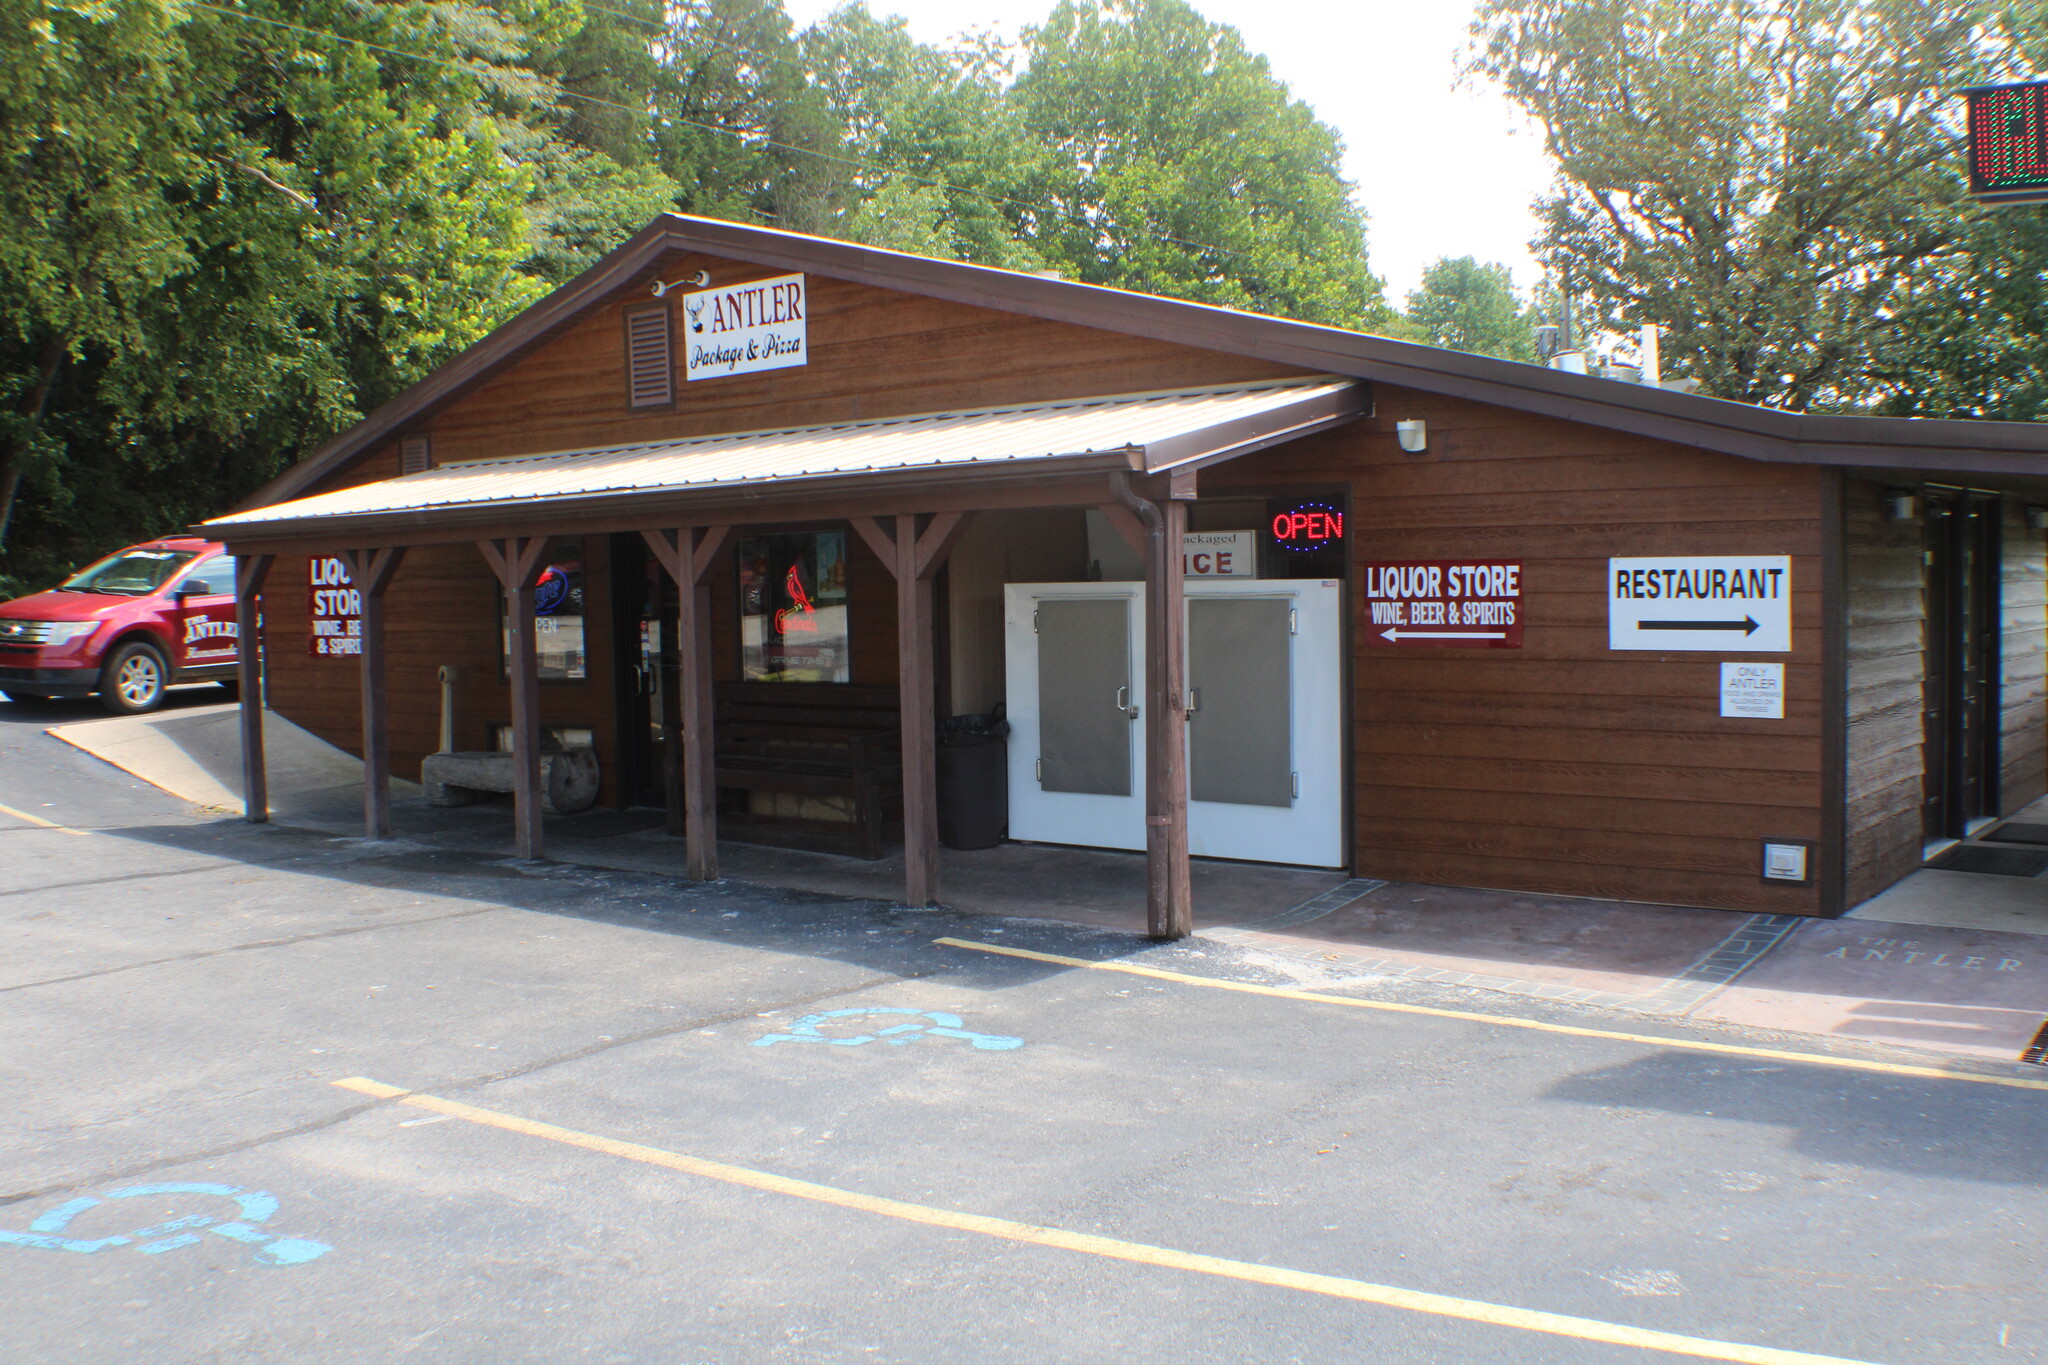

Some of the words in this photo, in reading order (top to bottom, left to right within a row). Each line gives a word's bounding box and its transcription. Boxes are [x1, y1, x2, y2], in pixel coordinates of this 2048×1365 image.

[711, 282, 803, 334] ANTLER
[690, 344, 744, 370] Package
[746, 338, 760, 361] &
[762, 334, 801, 359] Pizza
[1273, 513, 1342, 539] OPEN
[1184, 533, 1236, 545] ackaged
[311, 558, 351, 587] LIQU
[1367, 566, 1442, 600] LIQUOR
[1447, 565, 1520, 598] STORE
[1616, 568, 1784, 600] RESTAURANT
[314, 589, 361, 616] STOR
[1371, 602, 1408, 626] WINE,
[1410, 602, 1445, 625] BEER
[1448, 601, 1461, 625] &
[1462, 601, 1516, 625] SPIRITS
[313, 620, 346, 636] WINE,
[346, 620, 361, 635] BE
[535, 617, 558, 634] PEN
[317, 638, 329, 654] &
[329, 638, 362, 654] SPIRI
[1728, 678, 1777, 689] ANTLER
[1737, 667, 1768, 677] ONLY
[1857, 936, 1921, 949] THE
[1824, 946, 2025, 972] ANTLER
